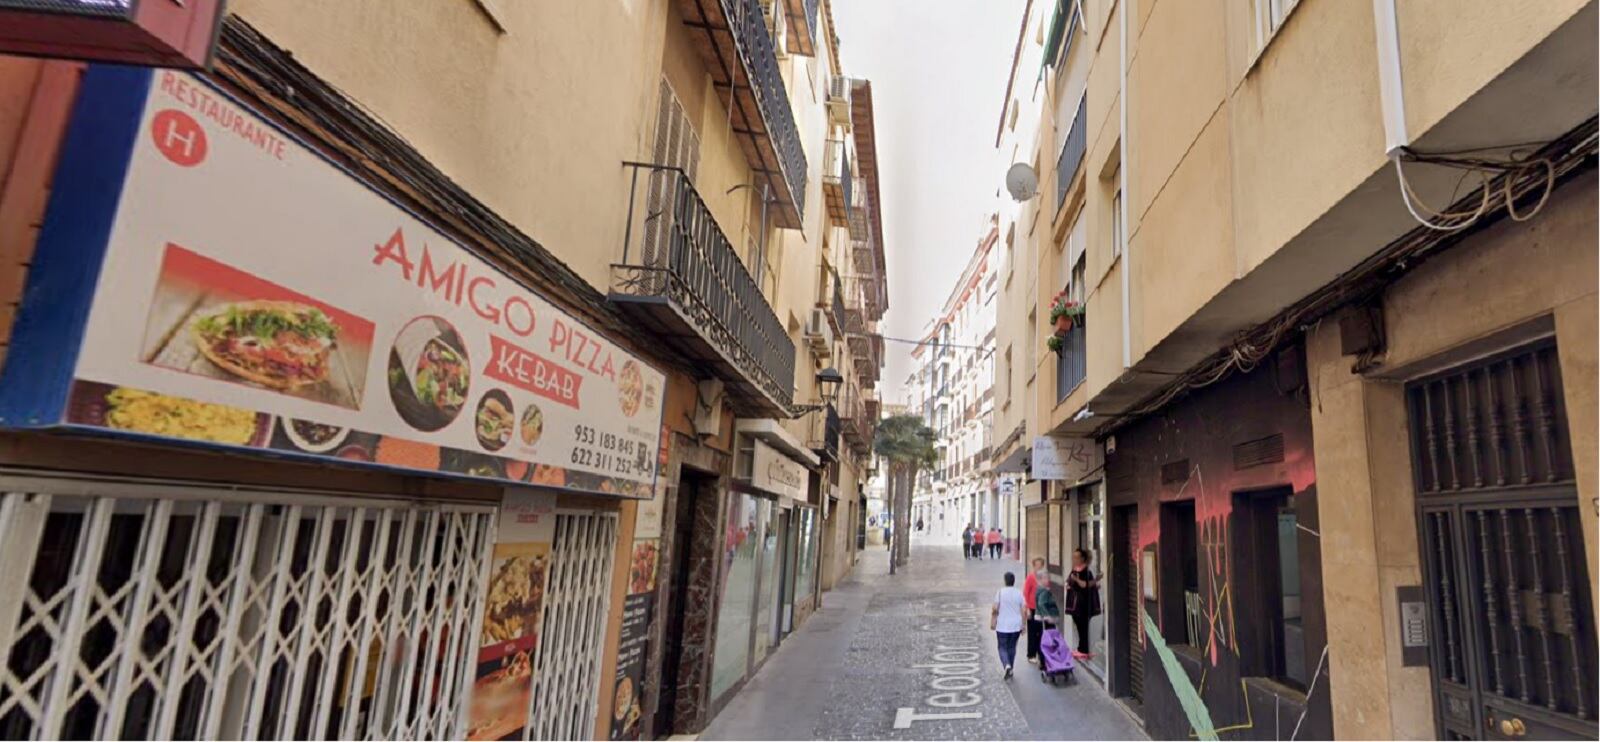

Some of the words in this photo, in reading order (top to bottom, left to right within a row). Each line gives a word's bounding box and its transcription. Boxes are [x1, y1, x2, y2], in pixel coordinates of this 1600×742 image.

[161, 70, 287, 161] RESTAURANTE
[165, 118, 196, 158] H
[372, 226, 536, 337] AMIGO
[549, 318, 616, 382] PIZZA
[497, 345, 574, 400] KEBAB
[570, 447, 593, 467] 622
[594, 452, 613, 473] 311
[615, 456, 632, 475] 252
[574, 424, 596, 446] 953
[599, 432, 617, 451] 183
[618, 438, 634, 456] 845
